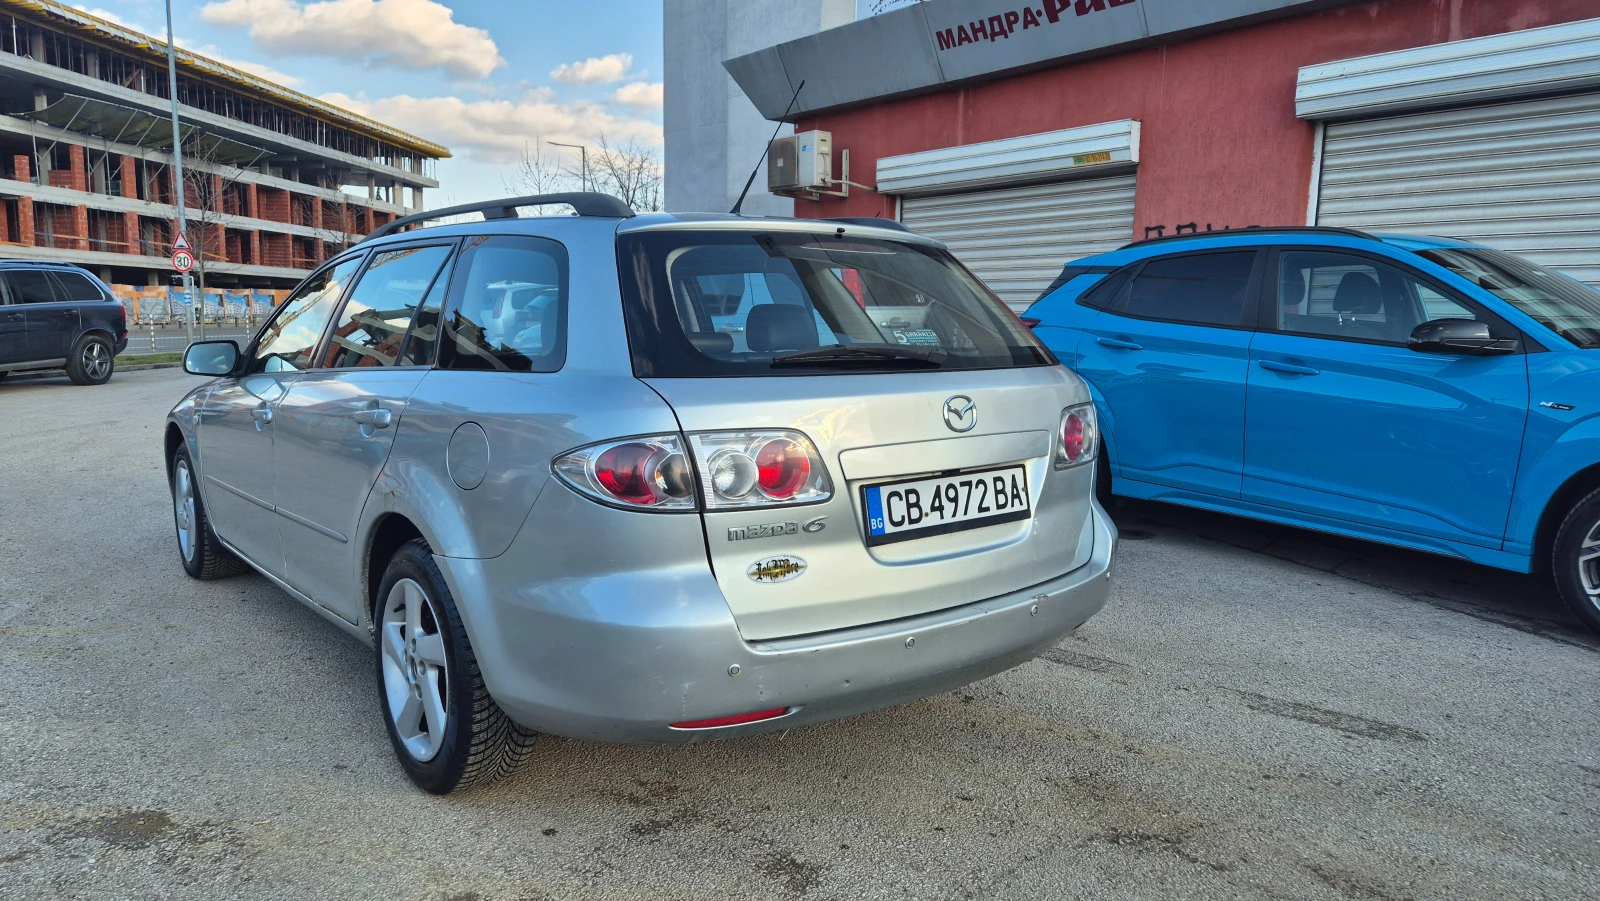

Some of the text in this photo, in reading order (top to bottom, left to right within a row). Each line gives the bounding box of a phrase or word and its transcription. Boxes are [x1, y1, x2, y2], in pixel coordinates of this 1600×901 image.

[935, 7, 1040, 51] МАНДРА
[176, 256, 189, 267] 30
[886, 474, 1023, 528] CB 4972 BA
[802, 515, 829, 533] 6
[871, 517, 884, 530] BG
